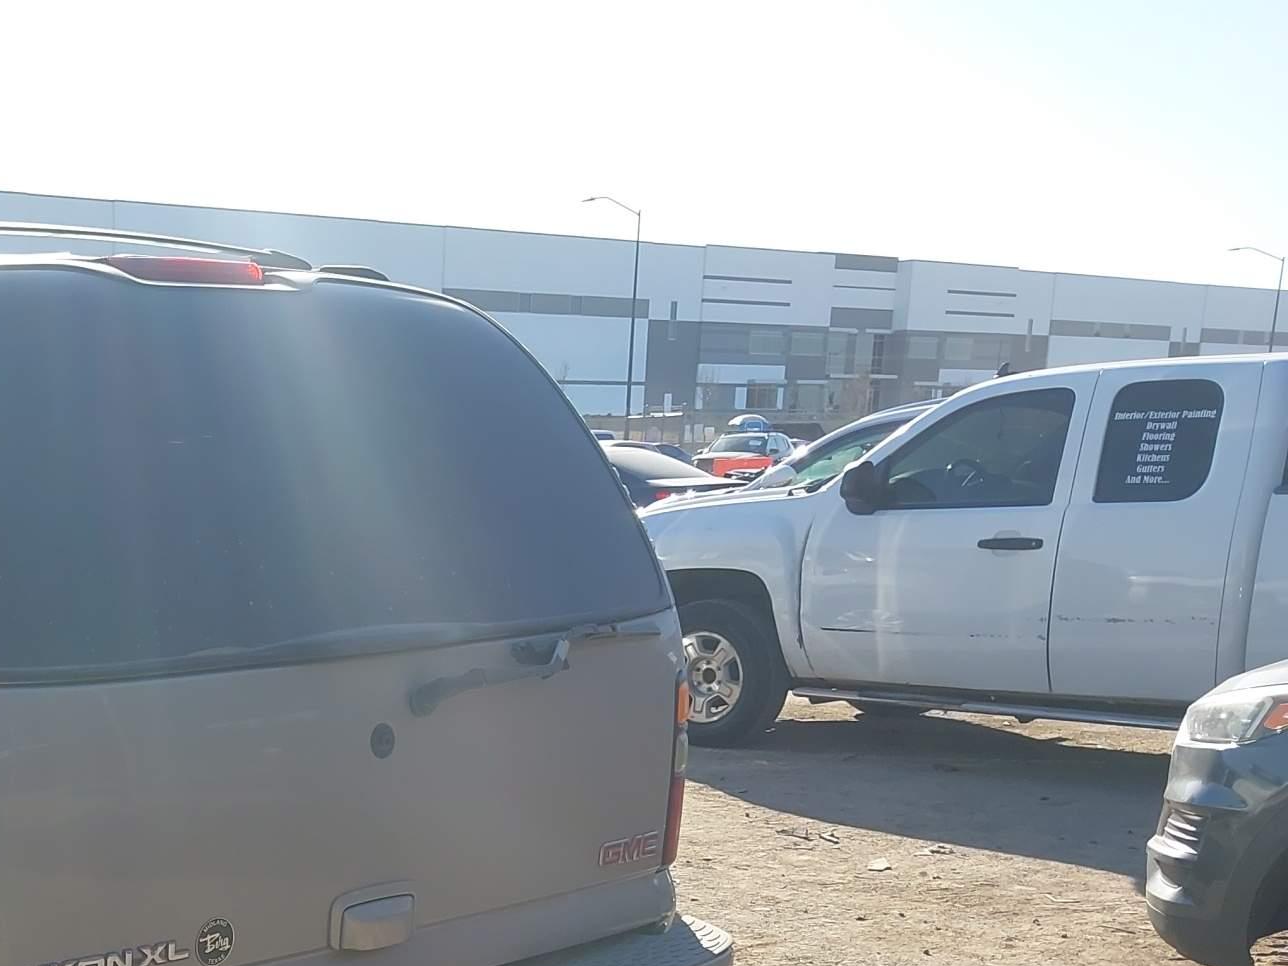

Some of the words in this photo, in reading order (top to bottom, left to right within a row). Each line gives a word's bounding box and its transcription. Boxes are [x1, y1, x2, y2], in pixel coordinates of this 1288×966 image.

[1114, 410, 1180, 421] Interior/Exterior
[1181, 409, 1217, 419] Painting
[1146, 421, 1178, 431] Drywall
[1142, 432, 1176, 442] Flooring
[1139, 443, 1172, 452] Showers
[1136, 454, 1171, 463] Kitchens
[1136, 464, 1165, 473] Gutters
[1125, 475, 1142, 484] And
